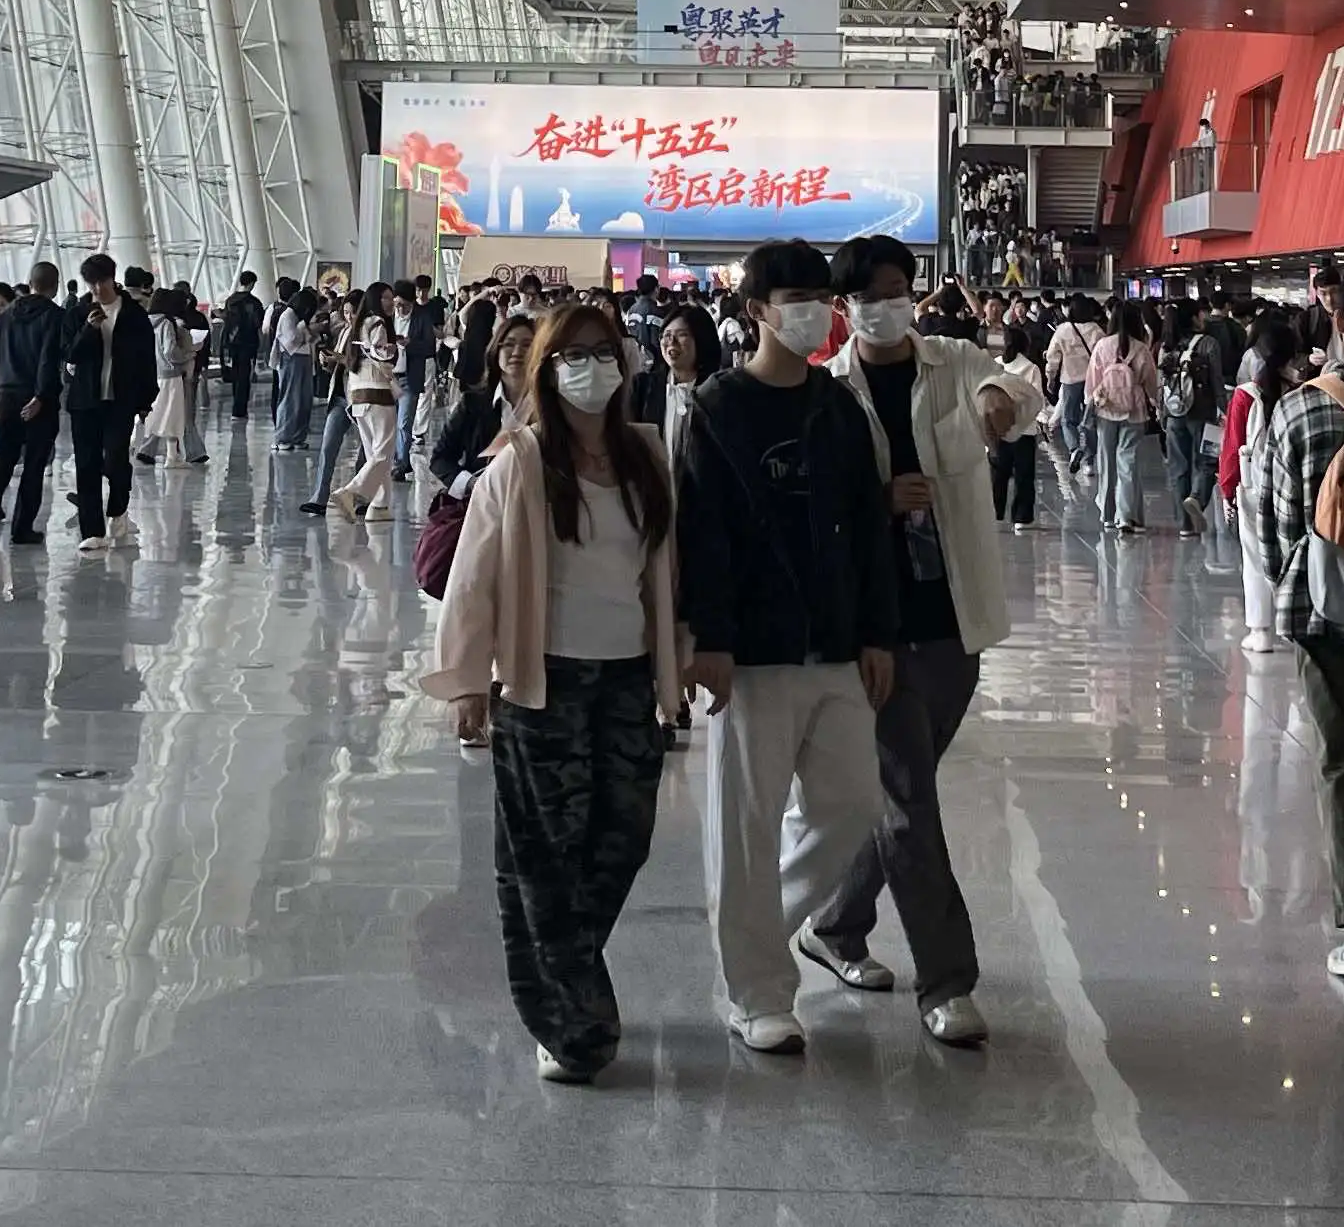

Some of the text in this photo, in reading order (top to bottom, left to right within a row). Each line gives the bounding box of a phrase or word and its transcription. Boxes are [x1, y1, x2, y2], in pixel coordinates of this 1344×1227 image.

[680, 2, 785, 42] 粤聚英才
[643, 163, 852, 216] 湾区启新程
